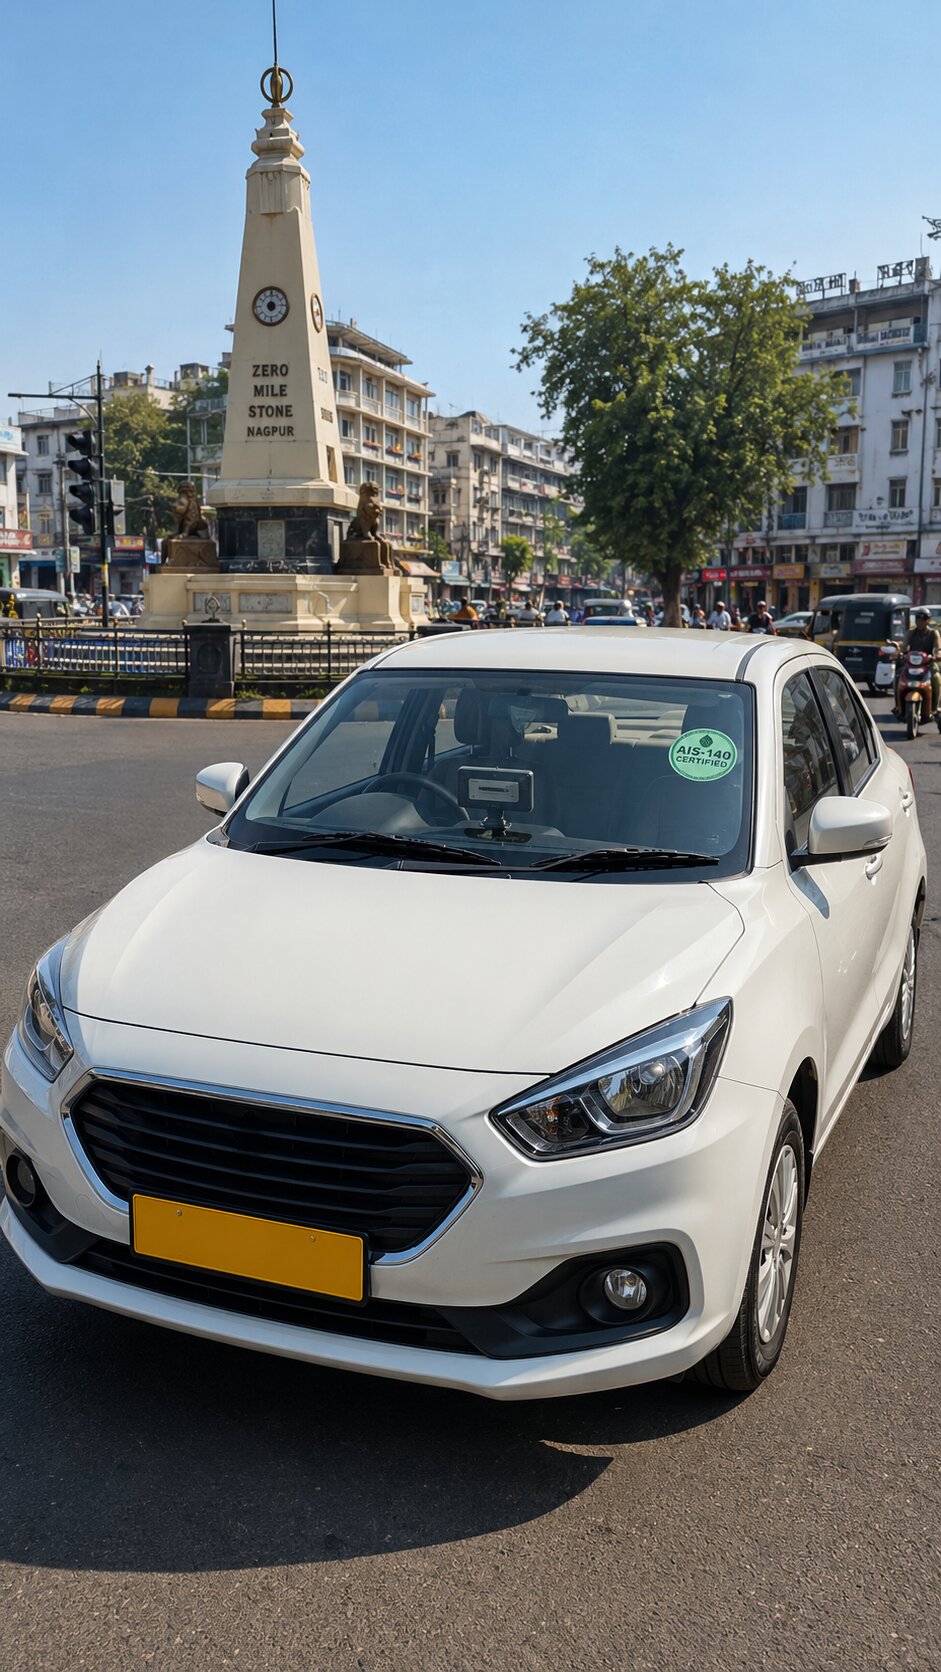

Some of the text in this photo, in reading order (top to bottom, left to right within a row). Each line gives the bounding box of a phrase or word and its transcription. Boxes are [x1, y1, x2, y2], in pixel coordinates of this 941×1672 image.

[252, 364, 289, 377] ZERO
[253, 384, 288, 397] MILE
[248, 404, 293, 418] STONE
[247, 426, 294, 437] NAGPUR
[676, 745, 732, 761] AIS-140
[675, 755, 728, 768] CERTIFIED
